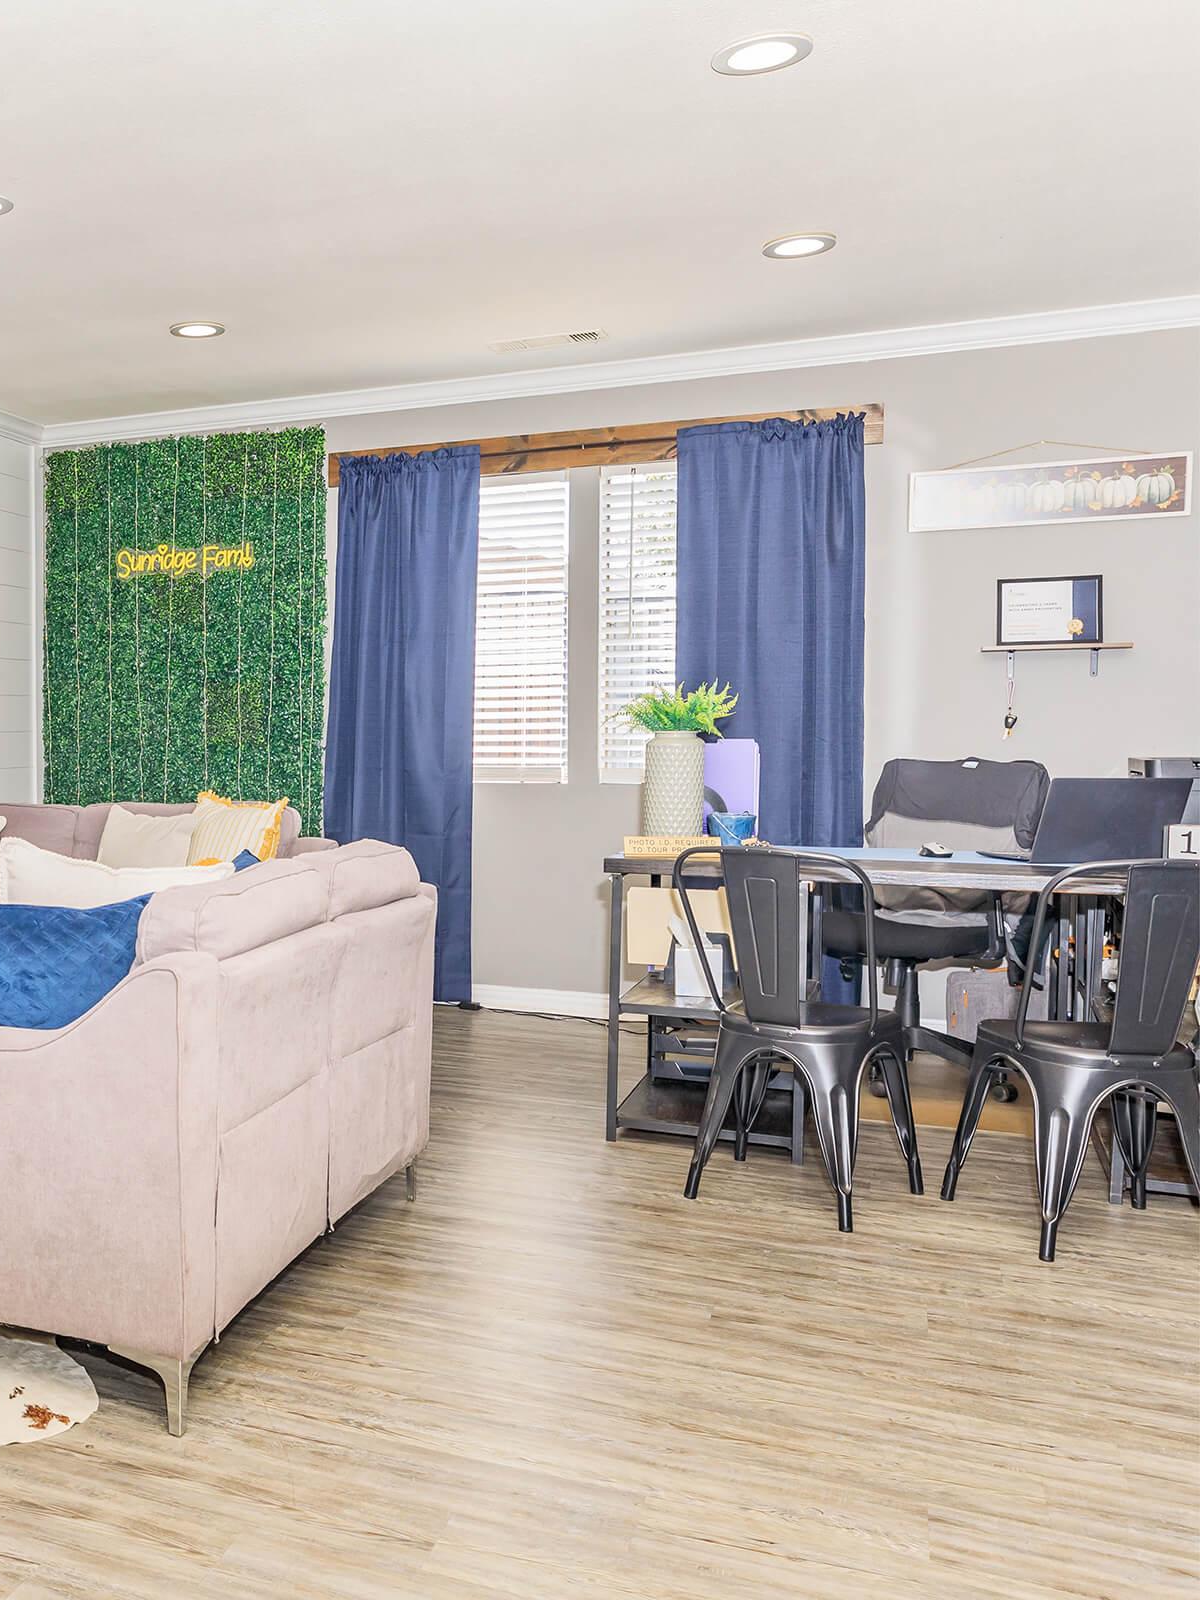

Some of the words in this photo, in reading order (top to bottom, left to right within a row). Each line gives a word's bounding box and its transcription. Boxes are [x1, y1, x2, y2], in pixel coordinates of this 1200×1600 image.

[117, 544, 197, 578] Sunridge
[203, 542, 254, 575] Fam!
[674, 839, 717, 847] REQUIRED
[1180, 831, 1198, 855] 1
